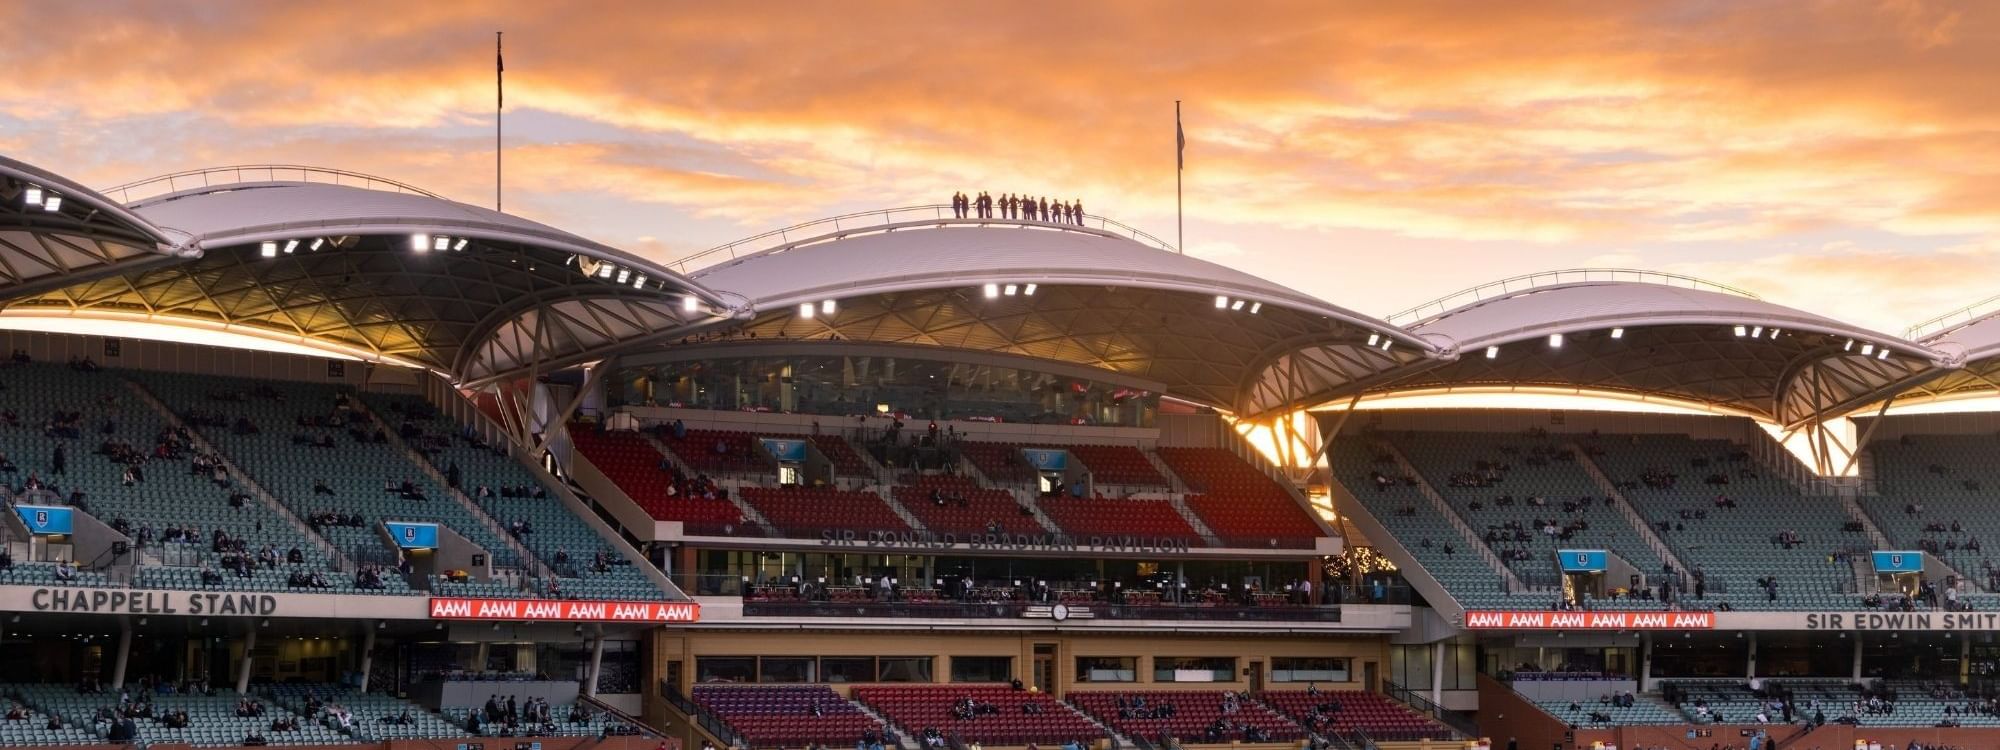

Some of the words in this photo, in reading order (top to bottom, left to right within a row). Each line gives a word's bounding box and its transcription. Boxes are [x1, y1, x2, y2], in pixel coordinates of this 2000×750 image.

[820, 528, 855, 546] SIR
[867, 530, 956, 549] DONALD
[969, 534, 1077, 551] BRADMAN
[1090, 536, 1190, 553] PAVILION
[32, 588, 177, 614] CHAPPELL
[189, 593, 277, 616] STAND
[432, 600, 471, 617] AAMI
[478, 601, 517, 618] AAMI
[524, 602, 561, 618] AAMI
[567, 602, 606, 619] AAMI
[612, 603, 649, 620] AAMI
[655, 604, 693, 621] AAMI
[1468, 613, 1502, 627] AAMI
[1509, 613, 1544, 627] AAMI
[1550, 613, 1585, 627] AAMI
[1591, 613, 1626, 627] AAMI
[1631, 614, 1667, 627] AAMI
[1673, 614, 1708, 627] AAMI
[1806, 613, 1843, 629] SIR
[1855, 613, 1931, 629] EDWIN
